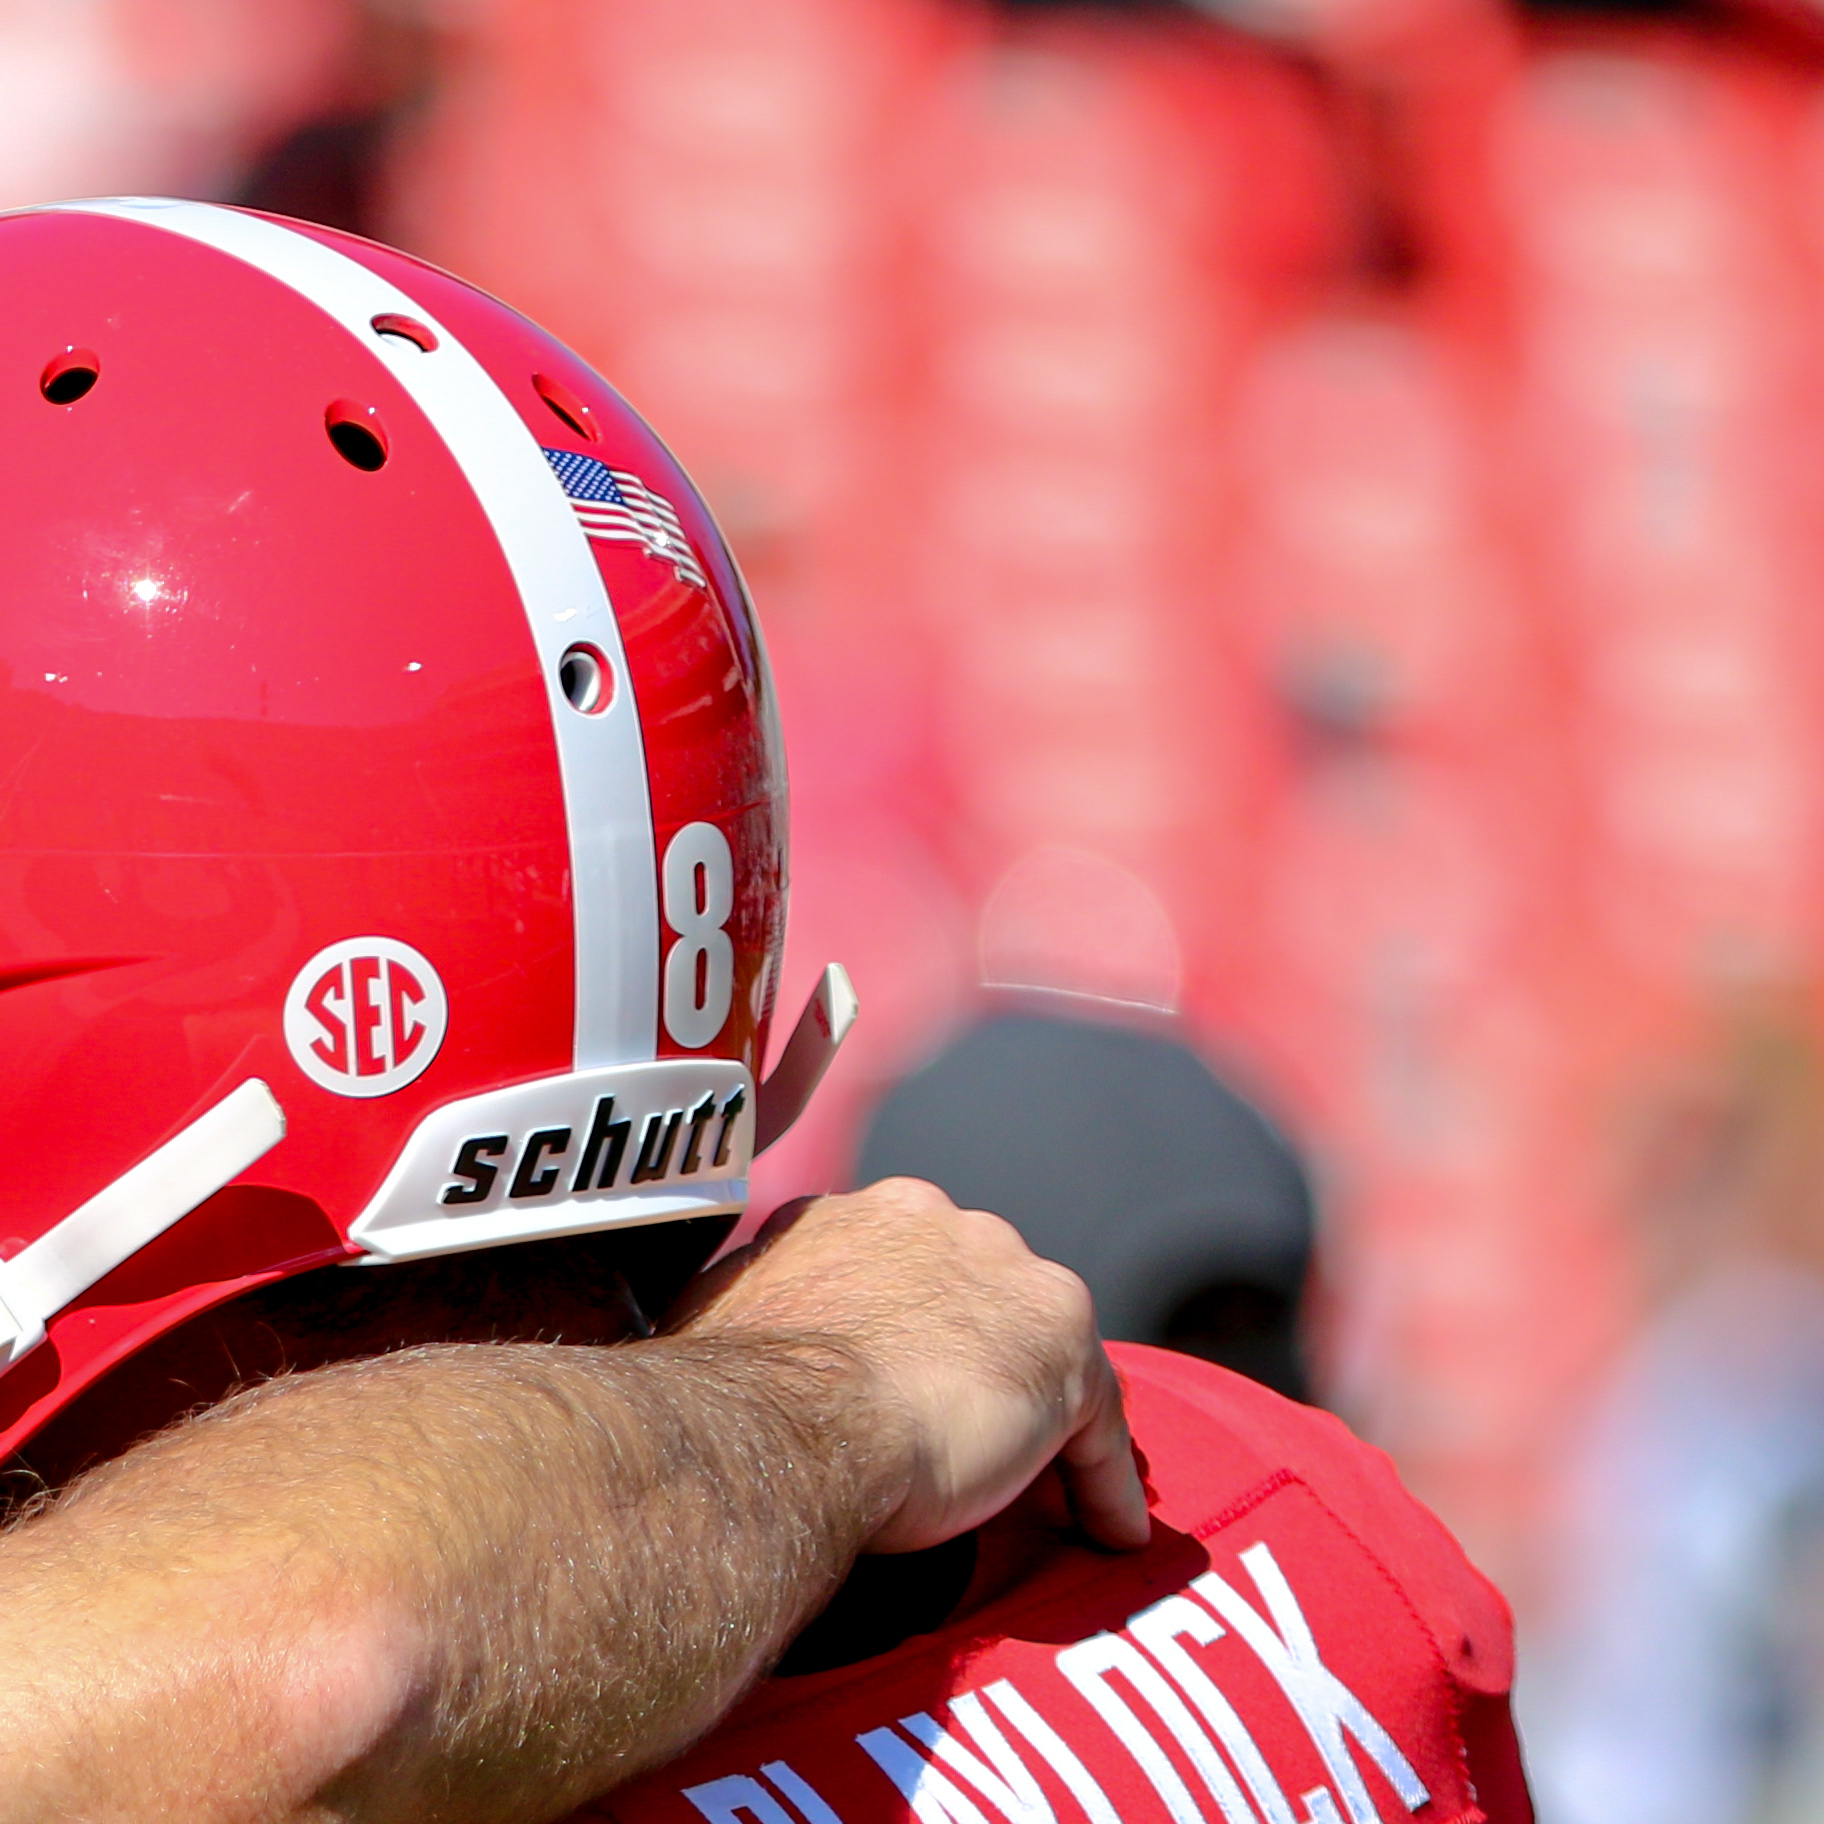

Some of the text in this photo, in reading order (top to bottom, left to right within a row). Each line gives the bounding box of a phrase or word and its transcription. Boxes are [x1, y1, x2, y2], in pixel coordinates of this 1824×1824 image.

[662, 820, 734, 1049] 8
[303, 956, 427, 1077] SEC
[438, 1084, 746, 1205] schutt
